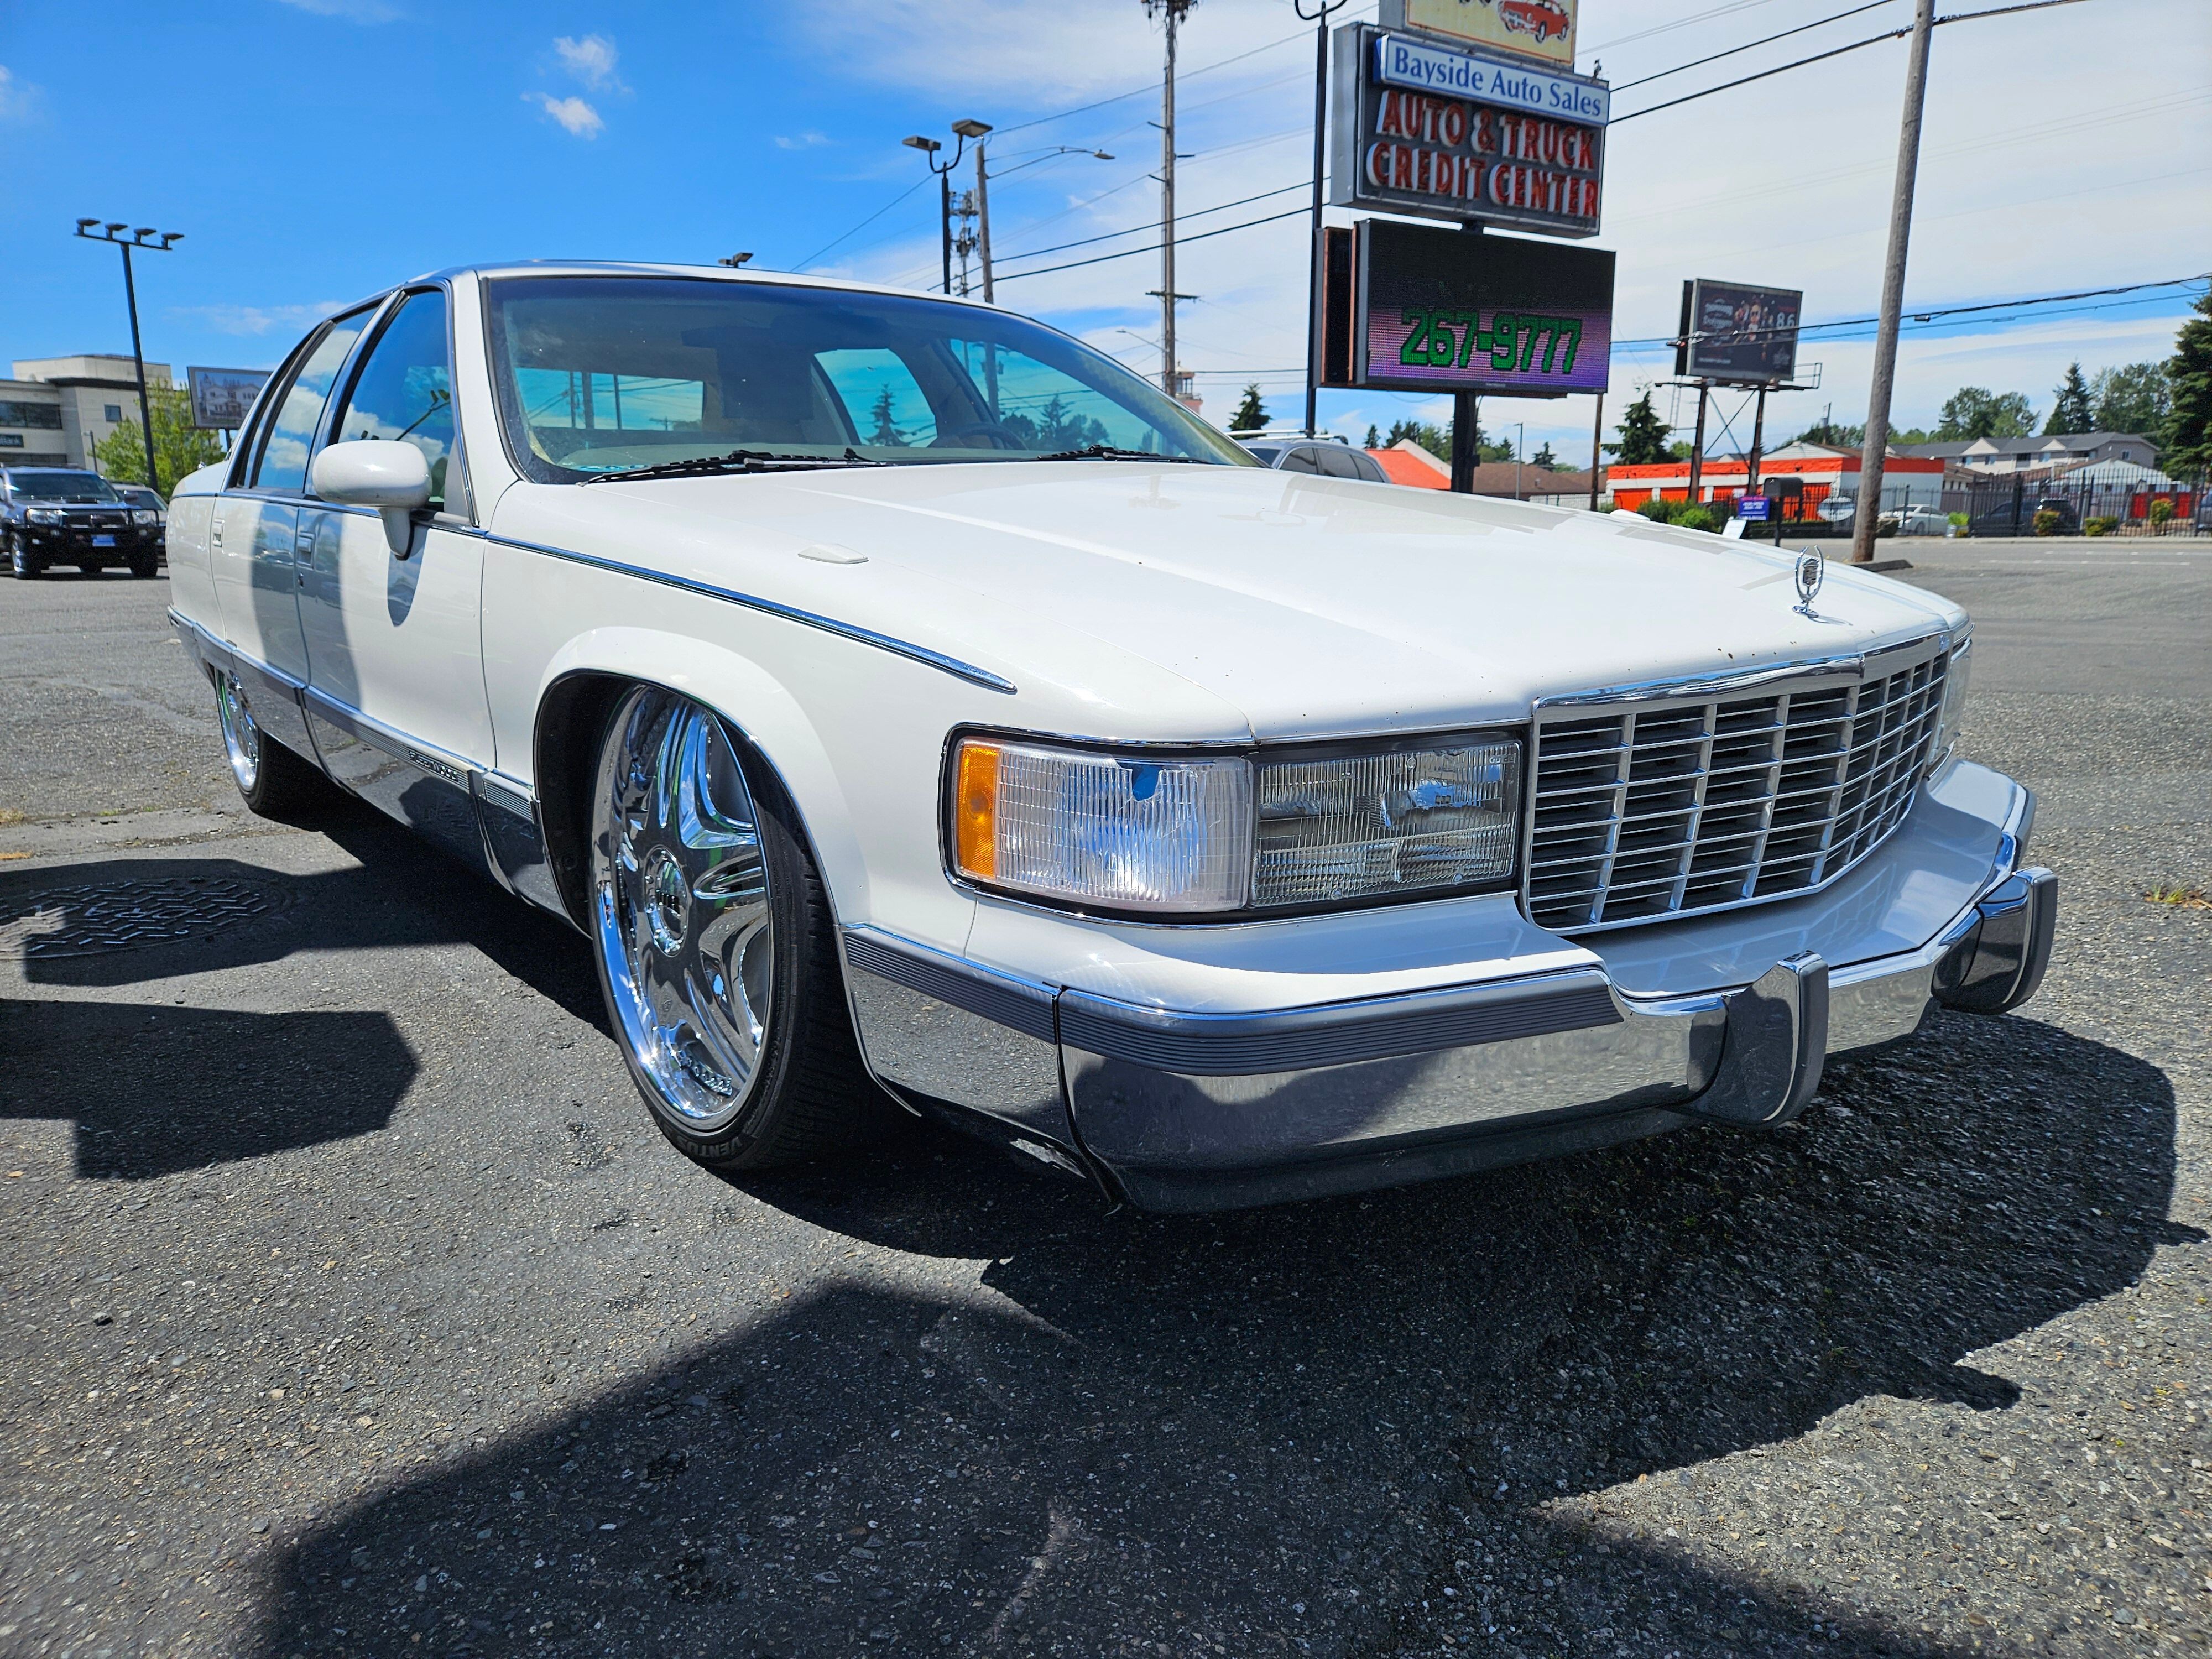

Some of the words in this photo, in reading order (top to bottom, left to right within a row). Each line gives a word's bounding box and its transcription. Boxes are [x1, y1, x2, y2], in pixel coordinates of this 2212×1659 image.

[1395, 46, 1483, 91] Bayside
[1490, 69, 1542, 103] Auto
[1549, 82, 1602, 116] Sales
[1376, 90, 1467, 148] AUTO
[1472, 109, 1496, 153] &
[1499, 114, 1594, 171] TRUCK
[1366, 142, 1486, 200] CREDIT
[1489, 163, 1598, 217] CENTER
[1400, 308, 1582, 374] 267-9777
